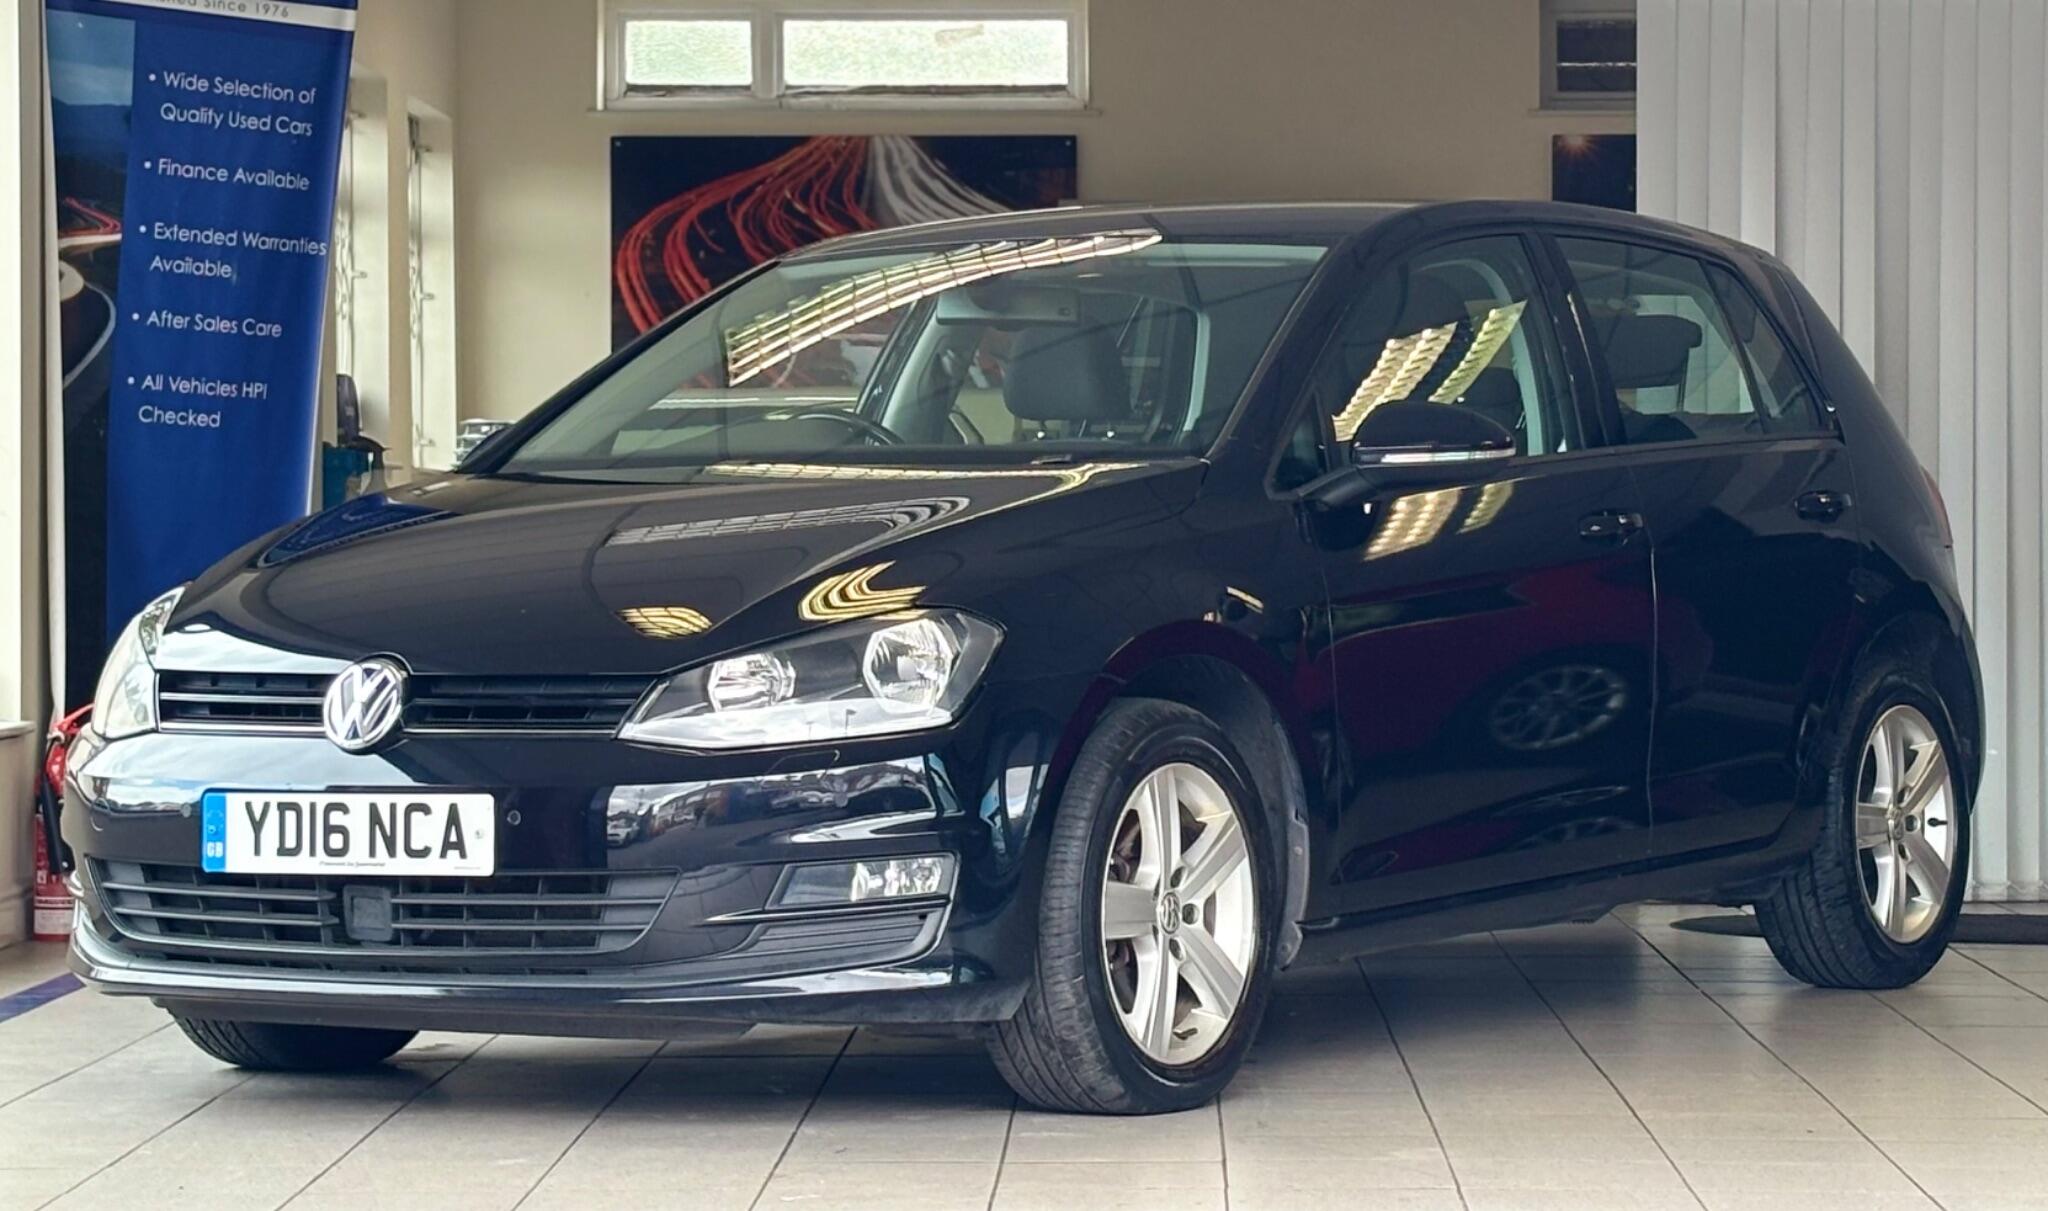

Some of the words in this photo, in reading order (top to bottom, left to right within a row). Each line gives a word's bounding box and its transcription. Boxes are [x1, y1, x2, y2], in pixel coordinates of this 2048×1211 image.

[203, 0, 247, 13] Since
[254, 3, 289, 18] 1976
[163, 71, 209, 92] Wide
[213, 77, 294, 103] Selection
[298, 87, 317, 104] of
[160, 103, 224, 129] Quality
[228, 111, 271, 131] Used
[275, 117, 313, 136] Cars
[158, 158, 228, 182] Finance
[233, 167, 310, 191] Available
[154, 222, 237, 247] Extended
[242, 231, 328, 256] Warranties
[146, 310, 190, 330] After
[194, 314, 238, 334] Sales
[242, 318, 282, 338] Care
[141, 375, 163, 391] All
[168, 377, 238, 398] Vehicles
[242, 382, 267, 399] HPI
[138, 405, 221, 428] Checked
[245, 801, 350, 858] YD16
[369, 802, 467, 859] NCA
